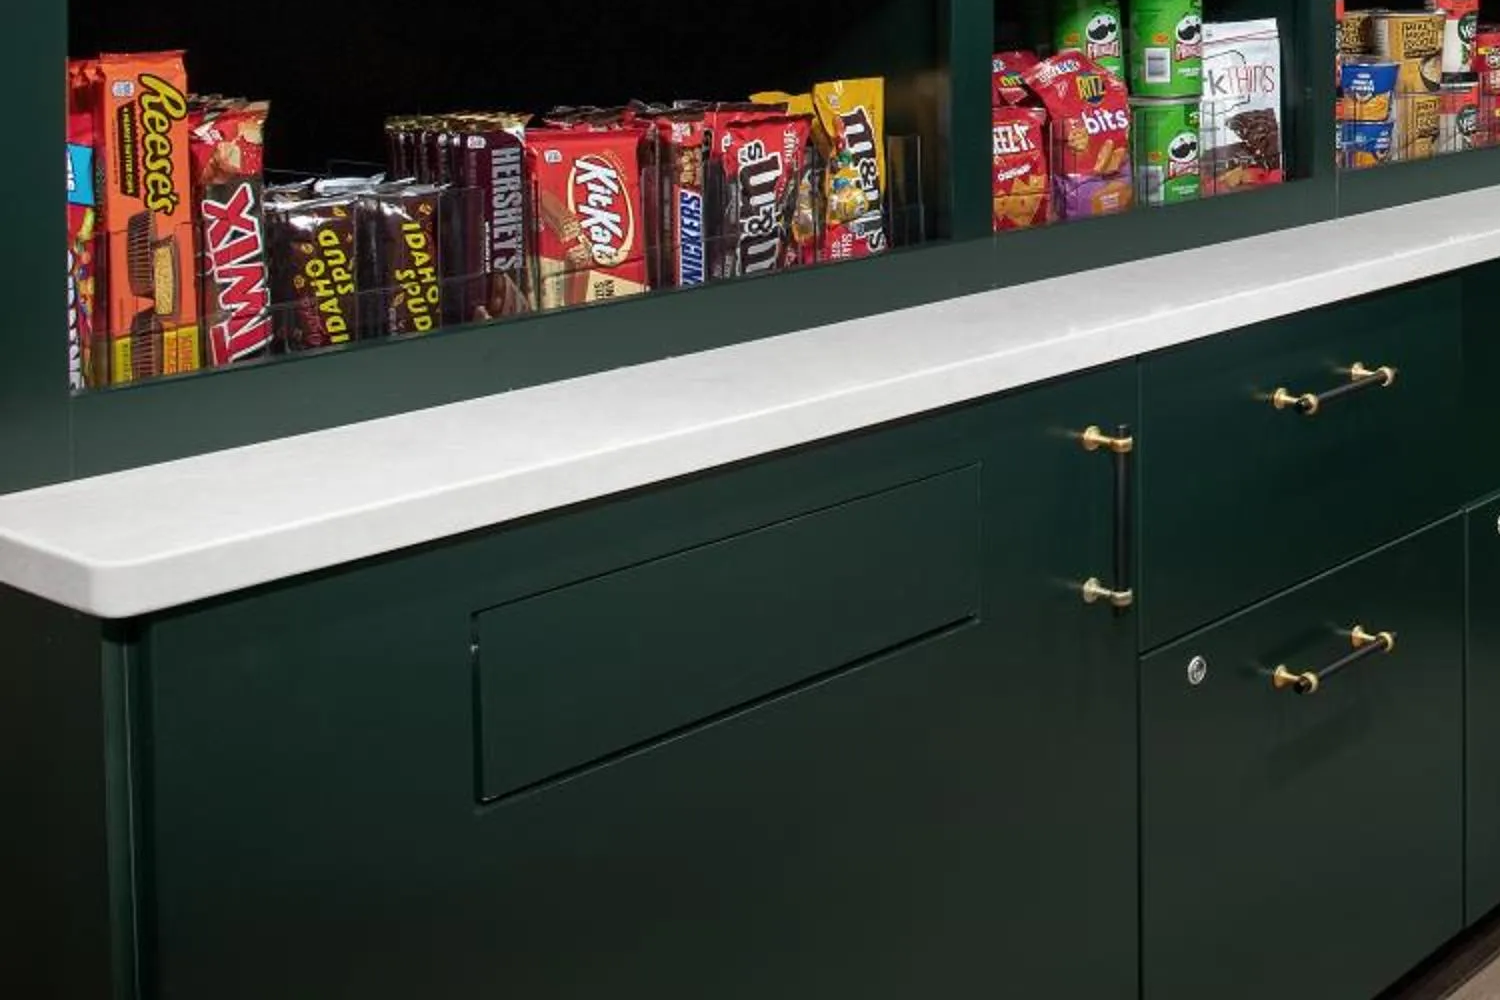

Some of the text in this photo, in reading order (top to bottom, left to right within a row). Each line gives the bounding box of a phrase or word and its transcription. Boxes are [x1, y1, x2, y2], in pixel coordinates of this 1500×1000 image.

[137, 72, 188, 214] Reese's
[1081, 109, 1129, 135] bits
[491, 147, 523, 271] HERSHEY'S
[201, 183, 275, 367] TWIX
[306, 258, 351, 344] IDAHO
[318, 228, 355, 296] SPUD
[395, 269, 433, 331] SPUD
[402, 222, 439, 305] IDAHO
